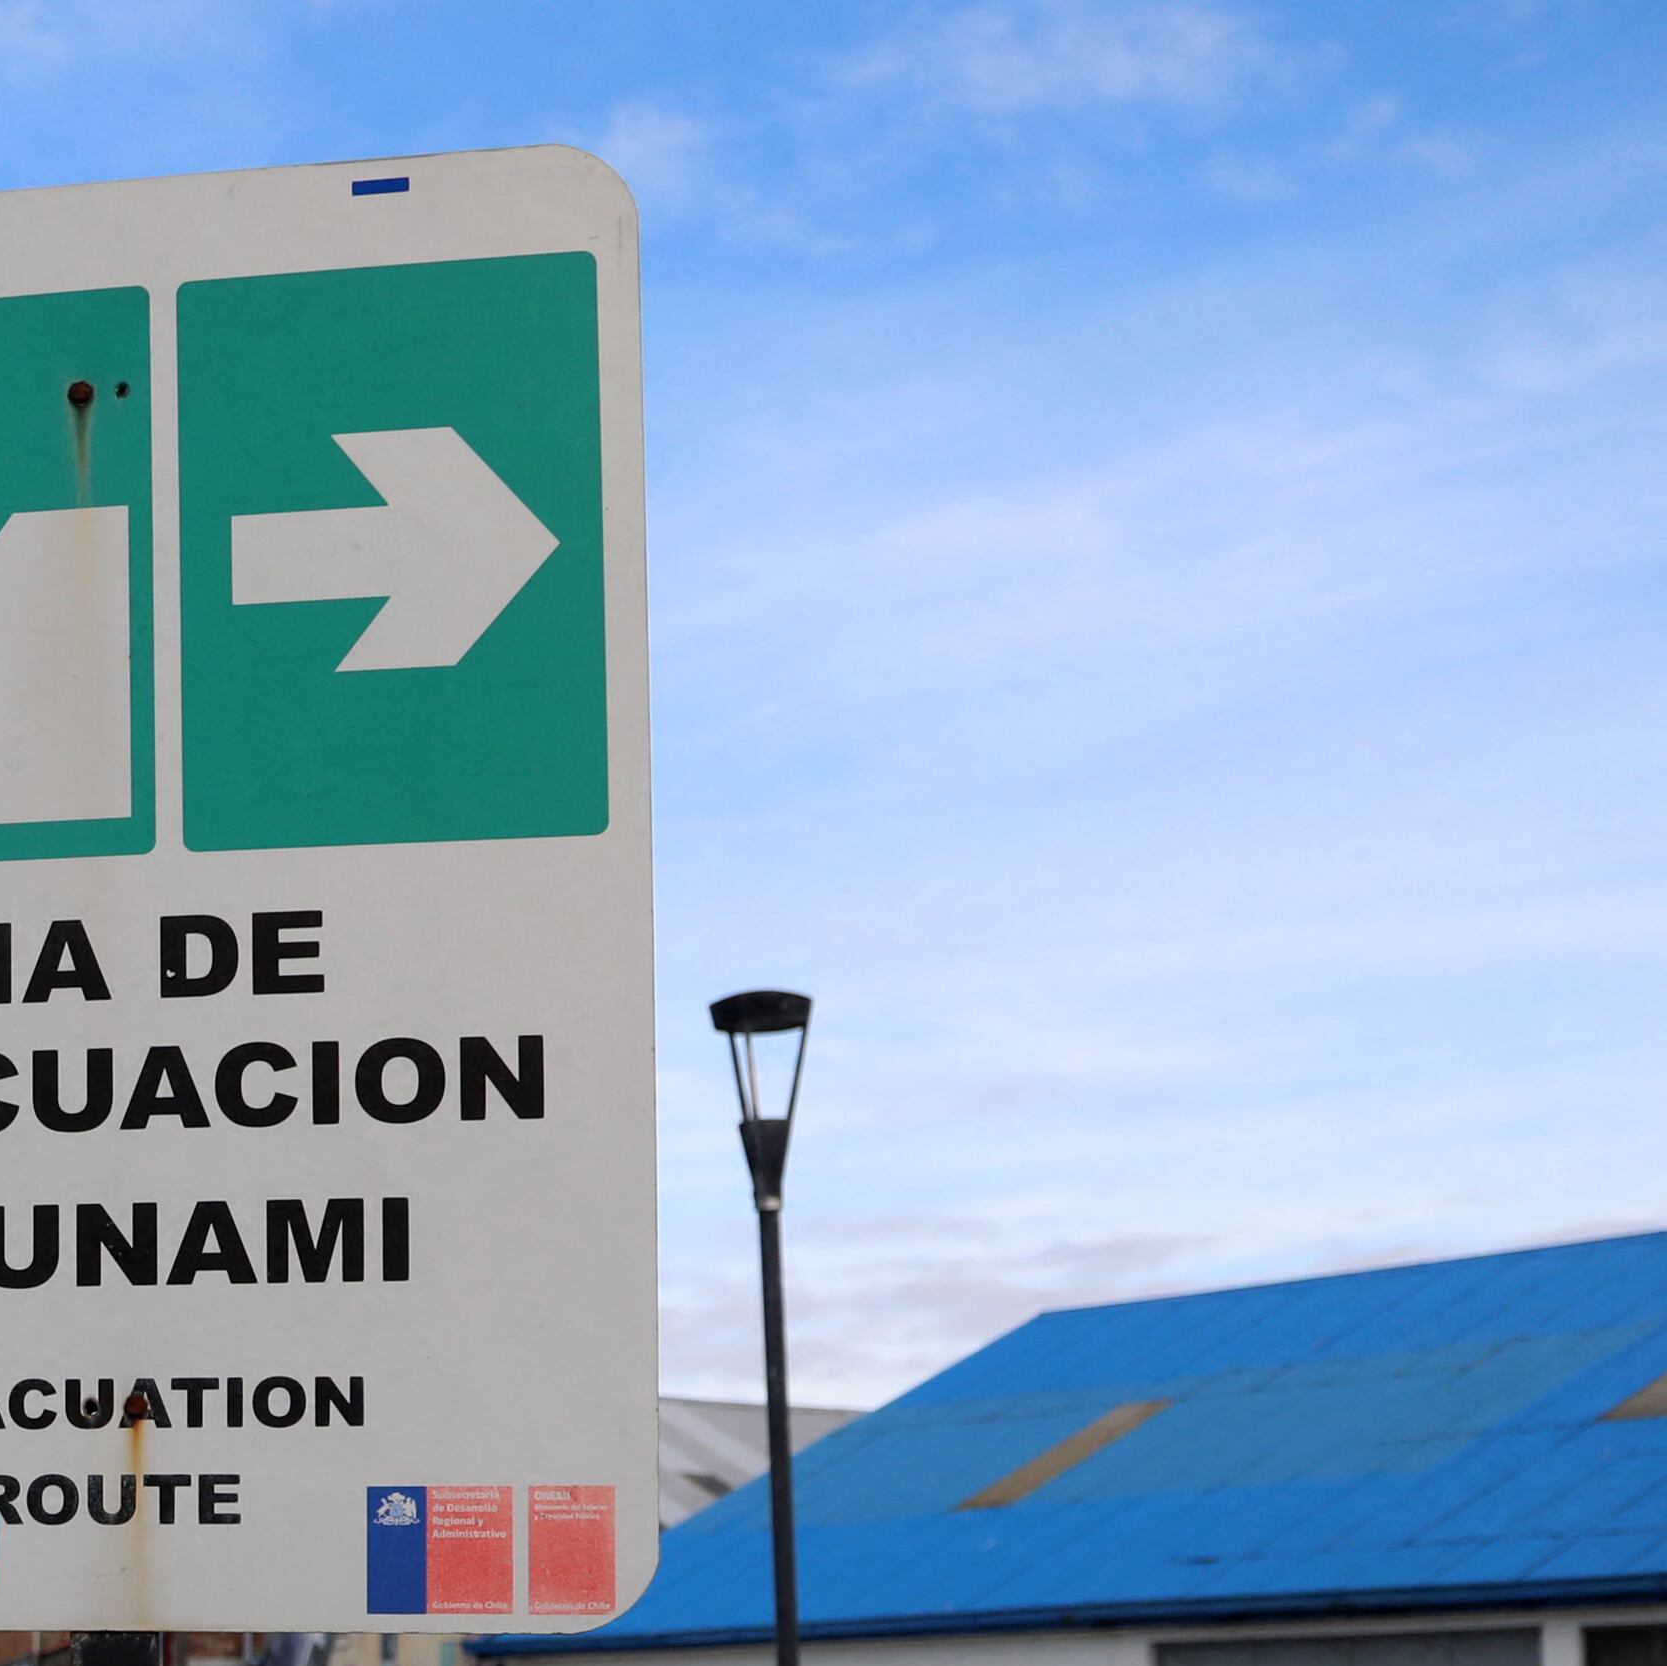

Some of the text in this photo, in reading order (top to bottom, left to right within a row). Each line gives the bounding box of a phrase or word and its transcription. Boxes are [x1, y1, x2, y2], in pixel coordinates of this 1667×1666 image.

[160, 911, 325, 998] DE
[432, 1502, 498, 1513] de Desarrollo
[432, 1516, 484, 1527] Regional y
[432, 1529, 507, 1539] Administrativo
